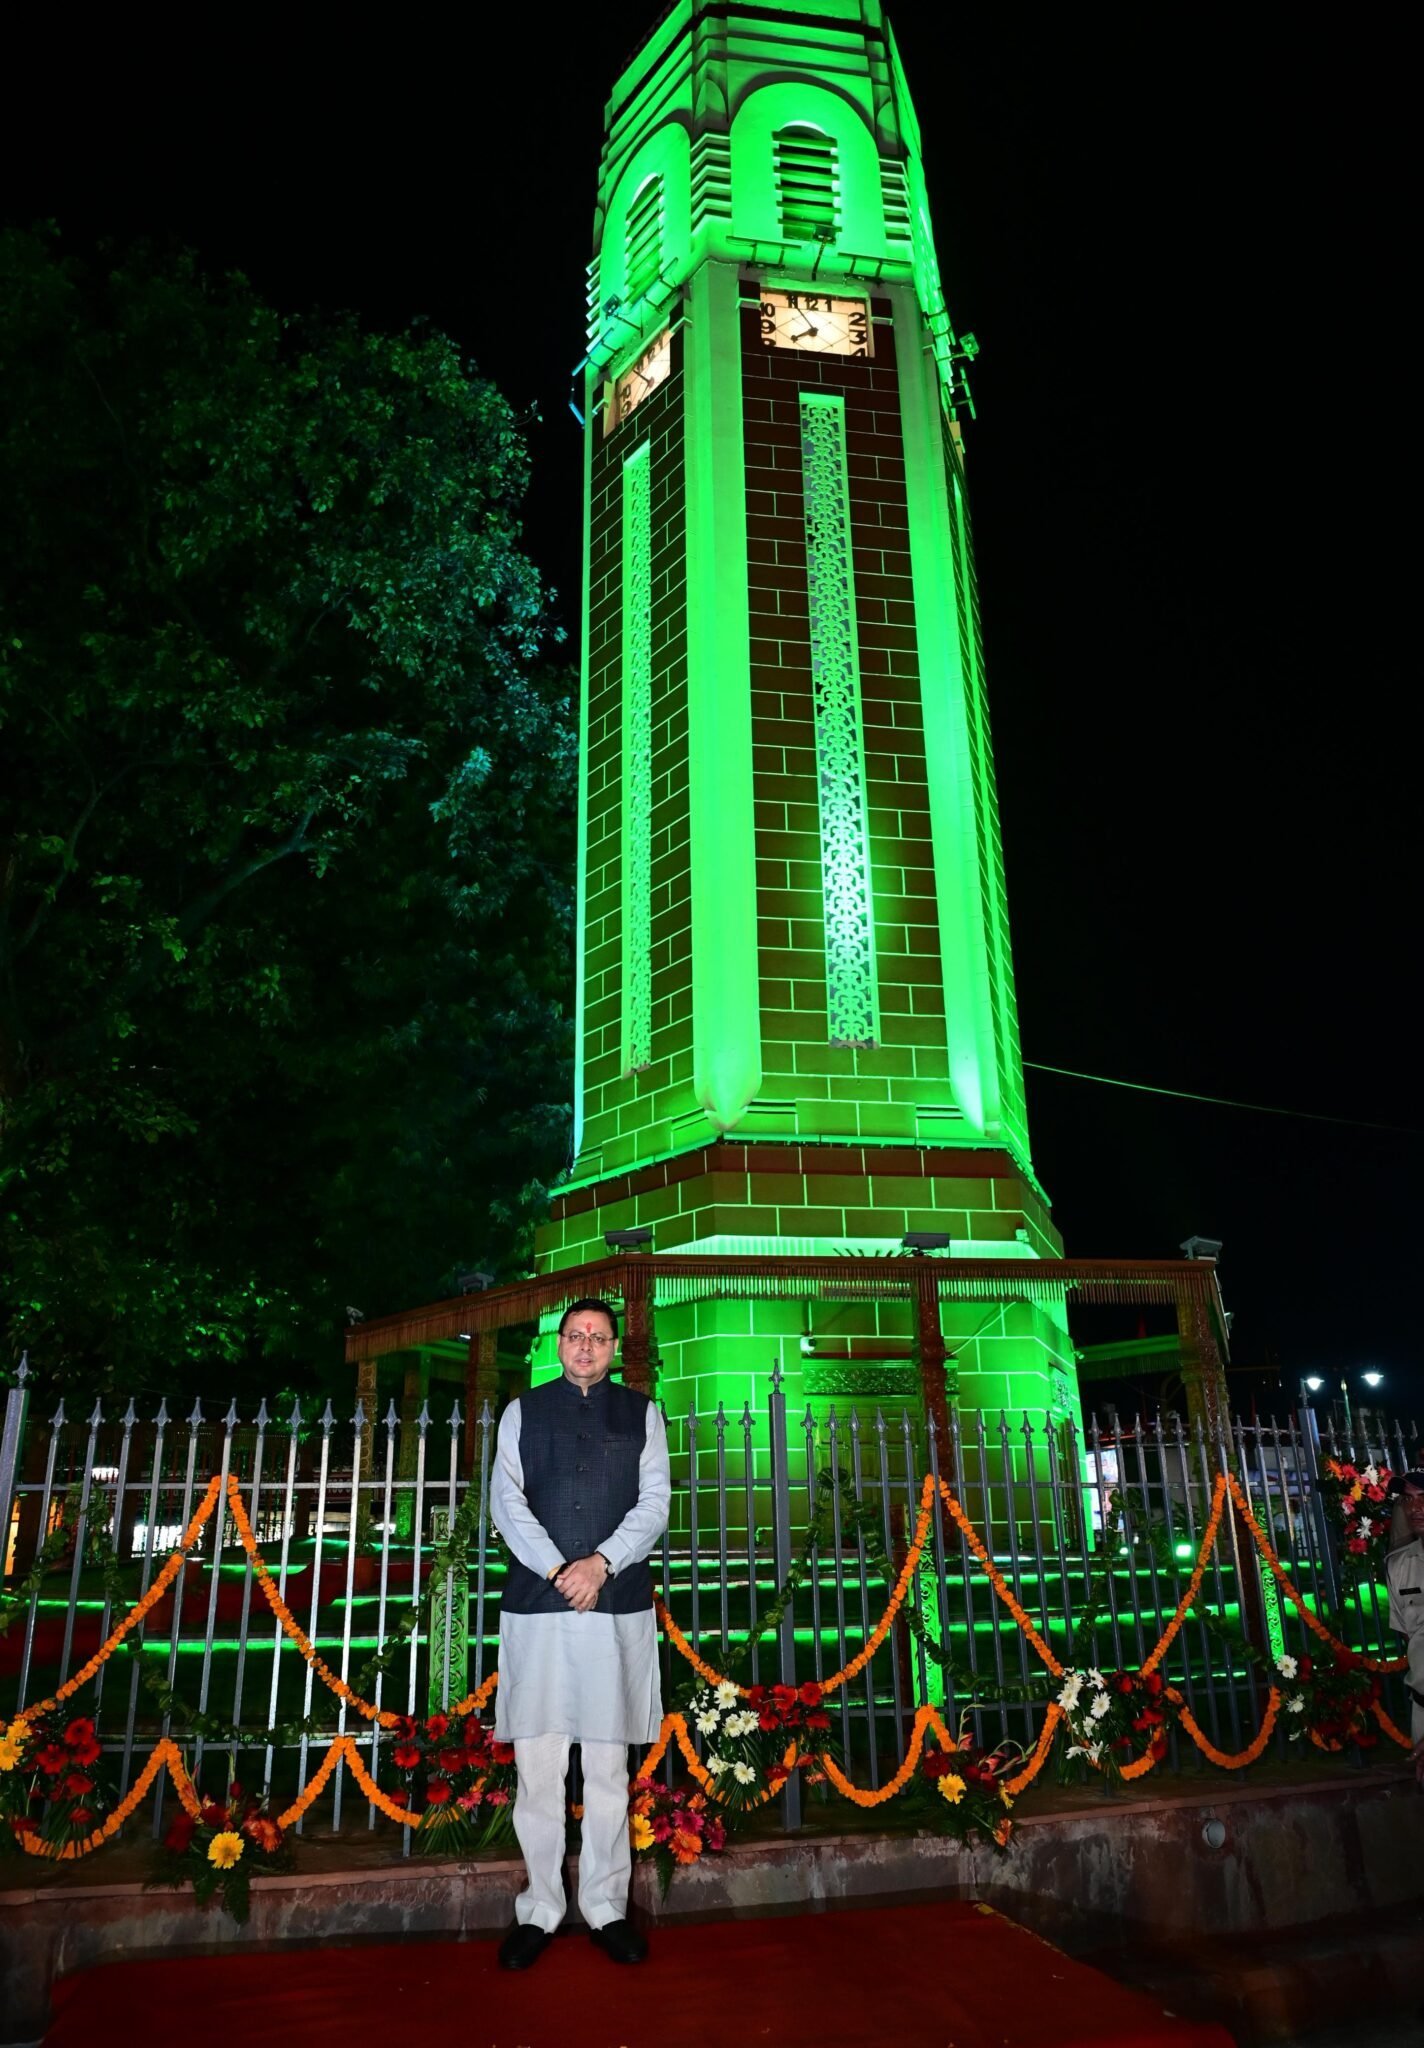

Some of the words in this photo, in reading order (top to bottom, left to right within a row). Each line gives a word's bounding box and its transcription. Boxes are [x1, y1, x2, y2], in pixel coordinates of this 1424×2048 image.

[760, 301, 775, 318] 10
[804, 295, 819, 311] 12
[825, 297, 832, 312] 1
[760, 318, 776, 335] 9
[848, 312, 866, 327] 2
[849, 328, 867, 345] 3
